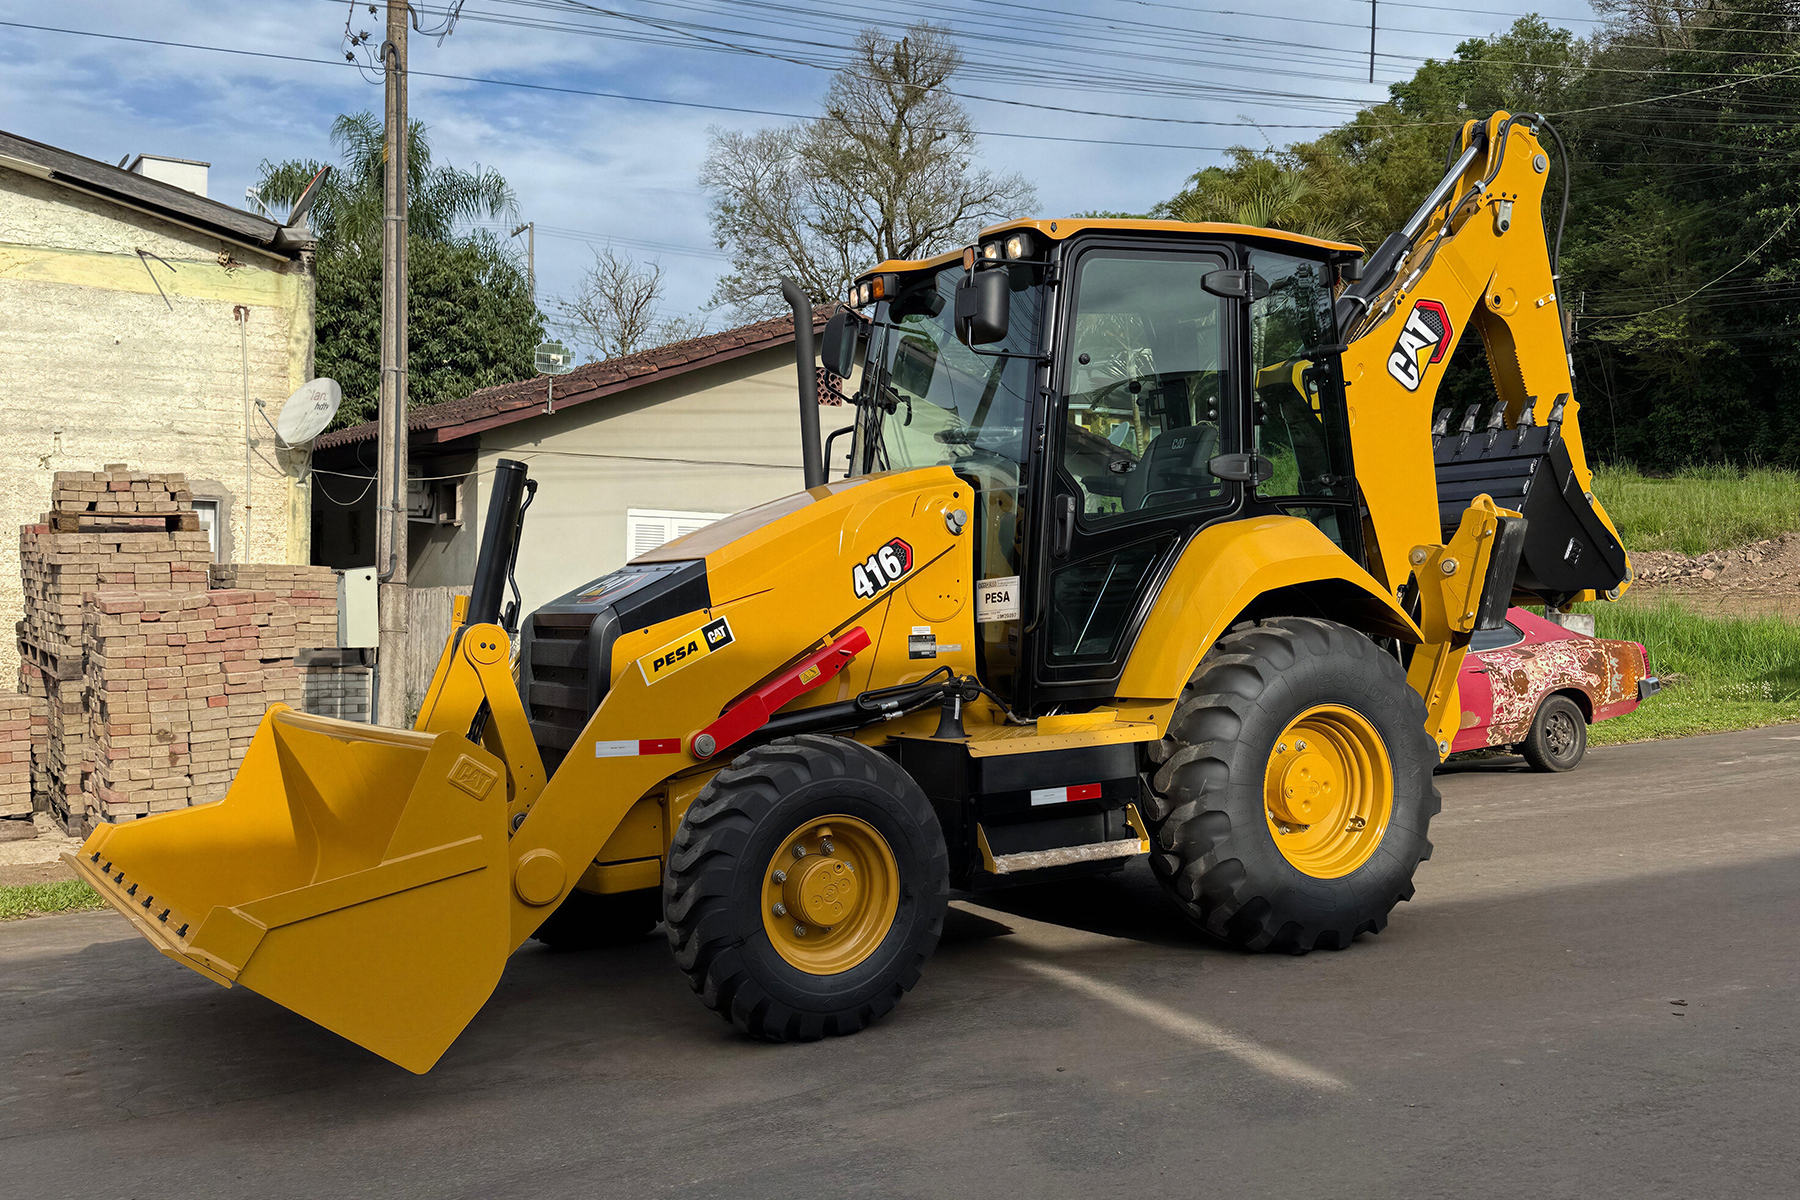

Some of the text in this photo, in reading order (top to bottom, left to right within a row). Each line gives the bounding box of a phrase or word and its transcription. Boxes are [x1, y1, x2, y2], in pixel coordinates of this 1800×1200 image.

[1387, 307, 1440, 390] CAT
[308, 389, 329, 401] lar
[1171, 437, 1187, 450] CAT
[853, 545, 902, 597] 416
[985, 590, 1011, 604] PESA
[652, 625, 727, 673] PESA CAT
[455, 762, 492, 793] CAT
